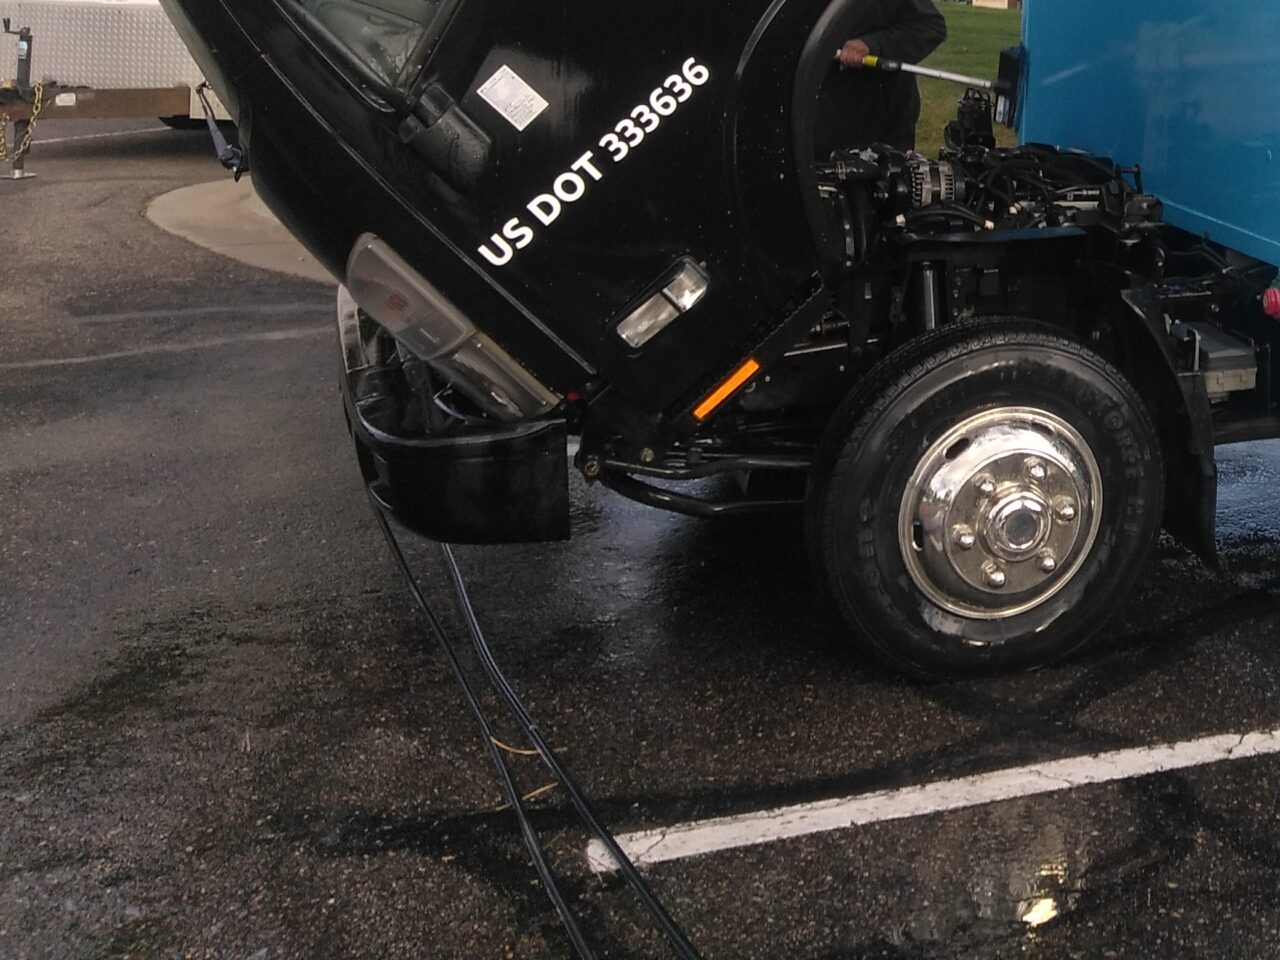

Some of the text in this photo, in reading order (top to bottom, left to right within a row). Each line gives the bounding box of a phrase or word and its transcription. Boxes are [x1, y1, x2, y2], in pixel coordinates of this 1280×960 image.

[477, 217, 534, 266] US
[526, 150, 603, 227] DOT
[598, 56, 710, 162] 333636
